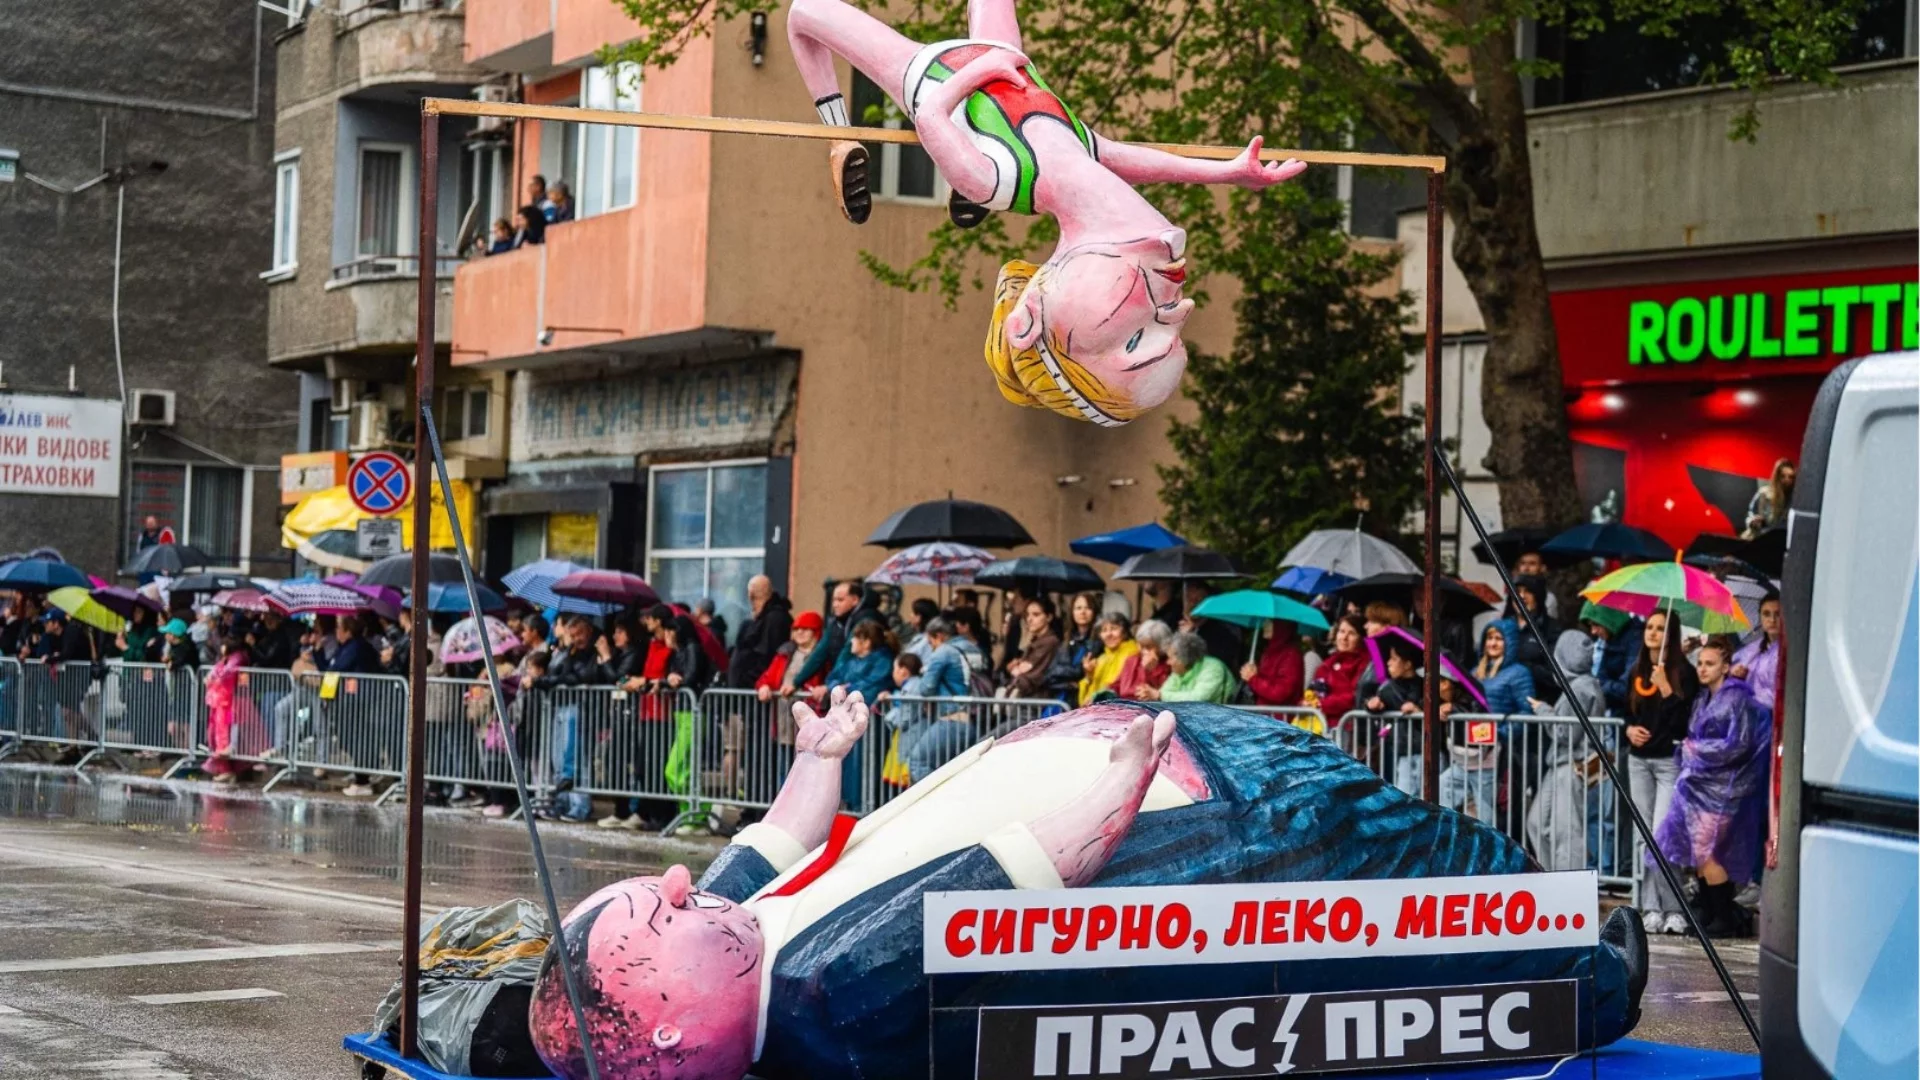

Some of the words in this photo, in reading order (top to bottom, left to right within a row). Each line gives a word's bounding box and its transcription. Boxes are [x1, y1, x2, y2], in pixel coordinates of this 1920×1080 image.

[46, 413, 72, 430] ИНС
[0, 435, 27, 456] КИ
[37, 436, 111, 462] ВИДОВЕ
[945, 902, 1208, 958] СИГУРНО,
[1223, 896, 1379, 947] ЛЕКО,
[1394, 890, 1585, 939] МЕКО...
[1033, 1007, 1256, 1077] ПРАС
[1325, 991, 1530, 1062] ПРЕС
